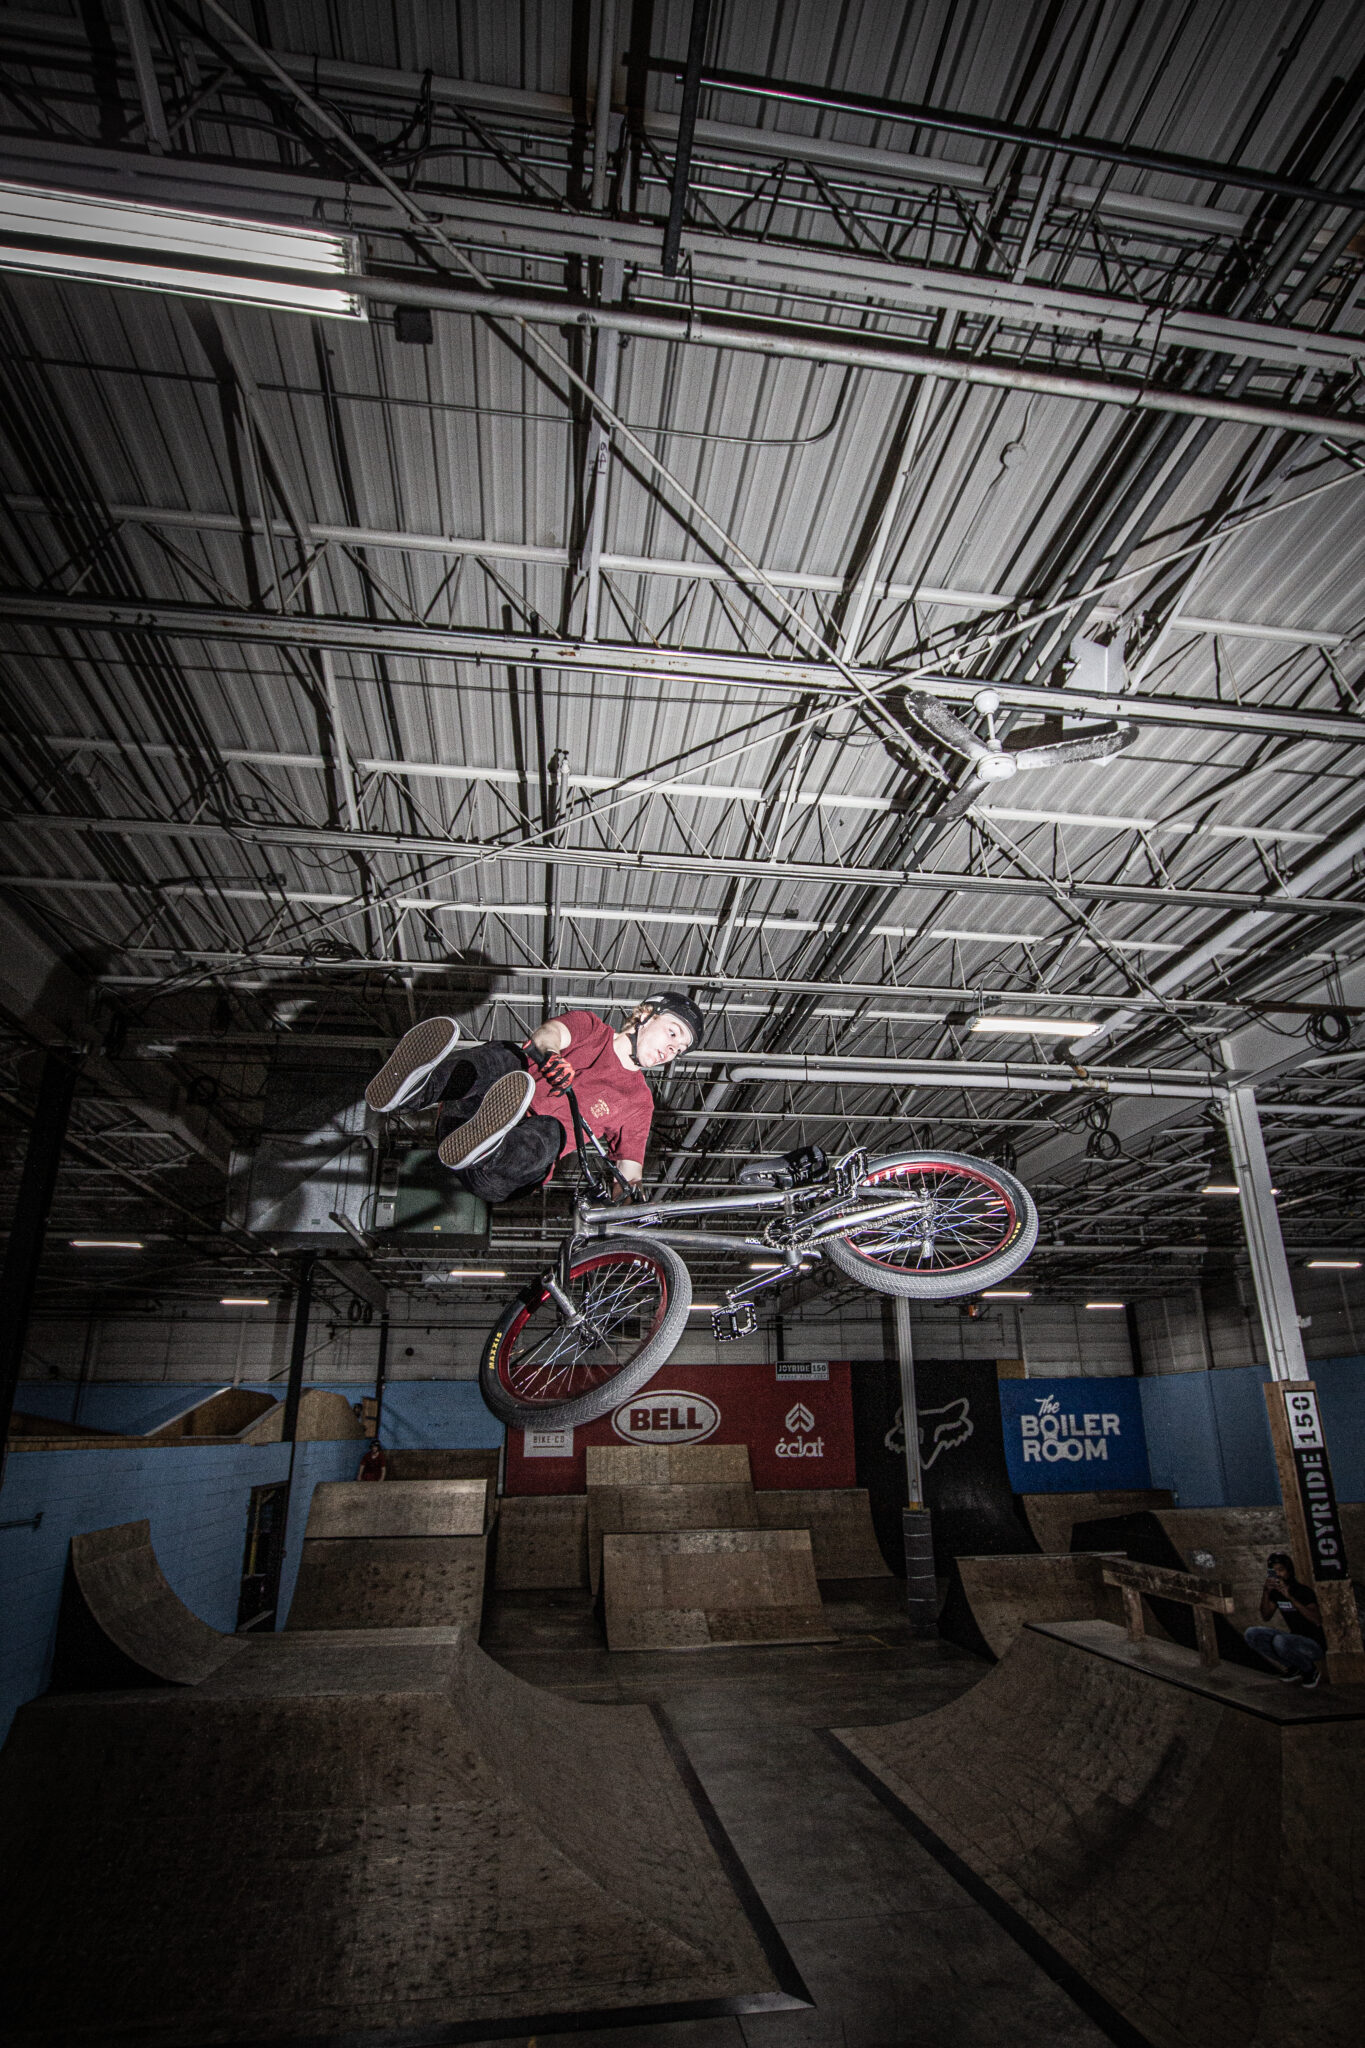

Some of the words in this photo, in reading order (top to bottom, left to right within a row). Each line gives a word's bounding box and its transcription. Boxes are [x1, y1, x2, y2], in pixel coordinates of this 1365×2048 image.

[778, 1363, 811, 1373] JOYRIDE
[812, 1364, 827, 1373] 150
[1034, 1394, 1061, 1416] The
[629, 1407, 704, 1432] BELL
[1020, 1412, 1122, 1438] BOILER
[1292, 1394, 1318, 1445] 150
[533, 1435, 551, 1444] BIKE
[775, 1436, 826, 1459] éclat
[1022, 1437, 1109, 1463] ROOM
[1301, 1452, 1342, 1572] JOYRIDE
